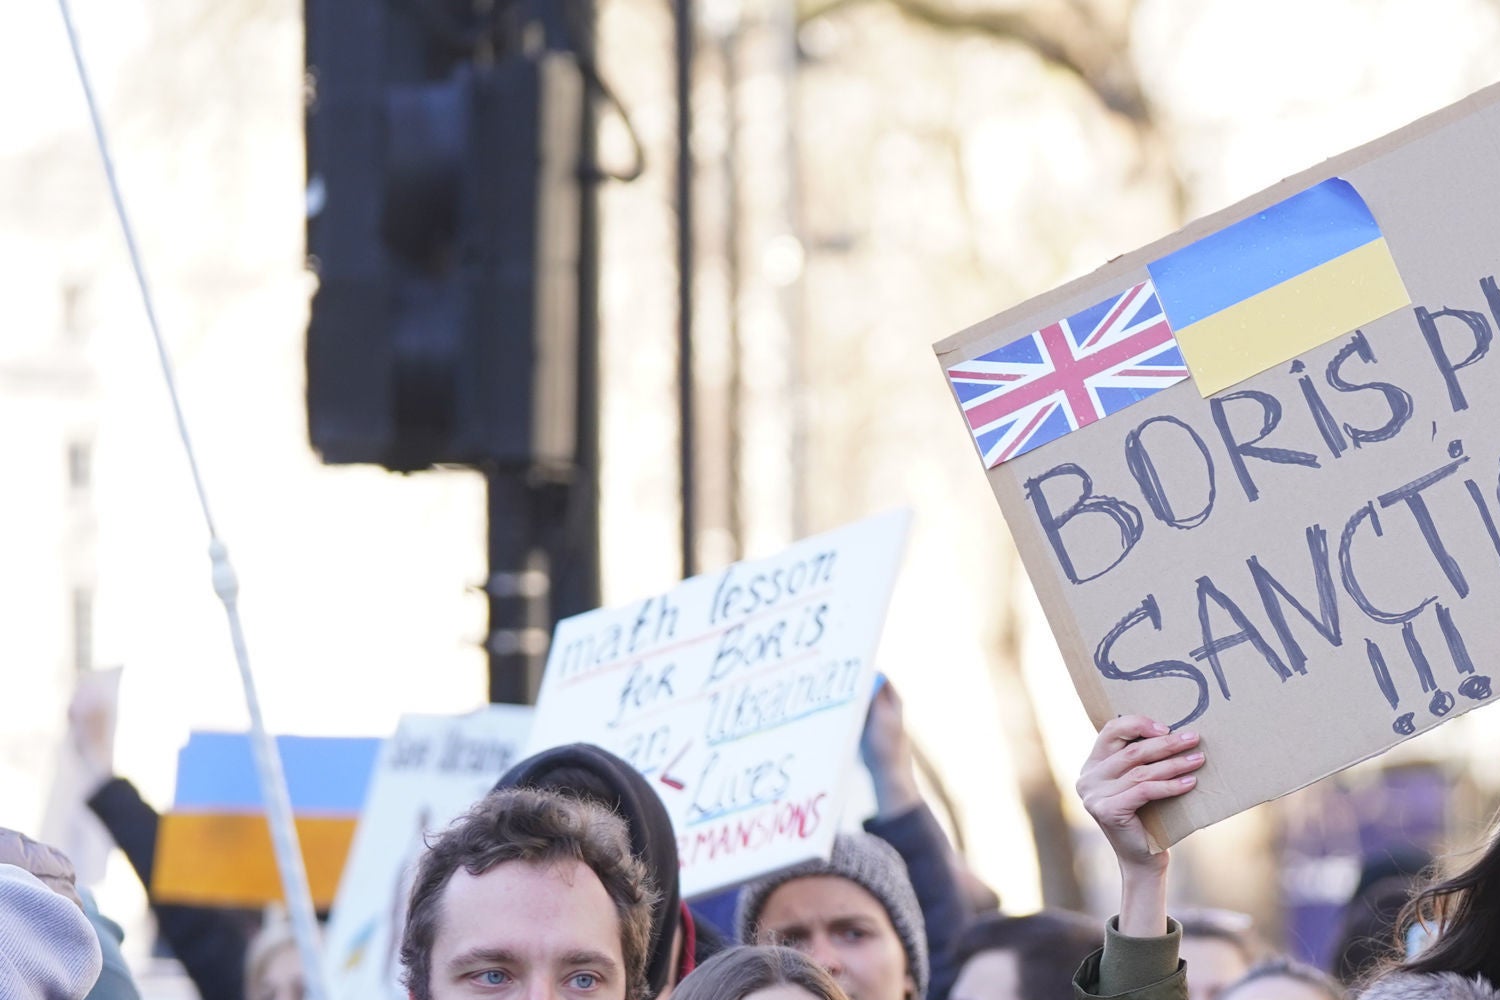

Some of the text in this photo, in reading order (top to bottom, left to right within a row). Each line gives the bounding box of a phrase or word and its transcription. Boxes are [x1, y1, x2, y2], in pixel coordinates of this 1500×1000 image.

[559, 550, 838, 678] math lesson
[1365, 603, 1492, 736] !!!
